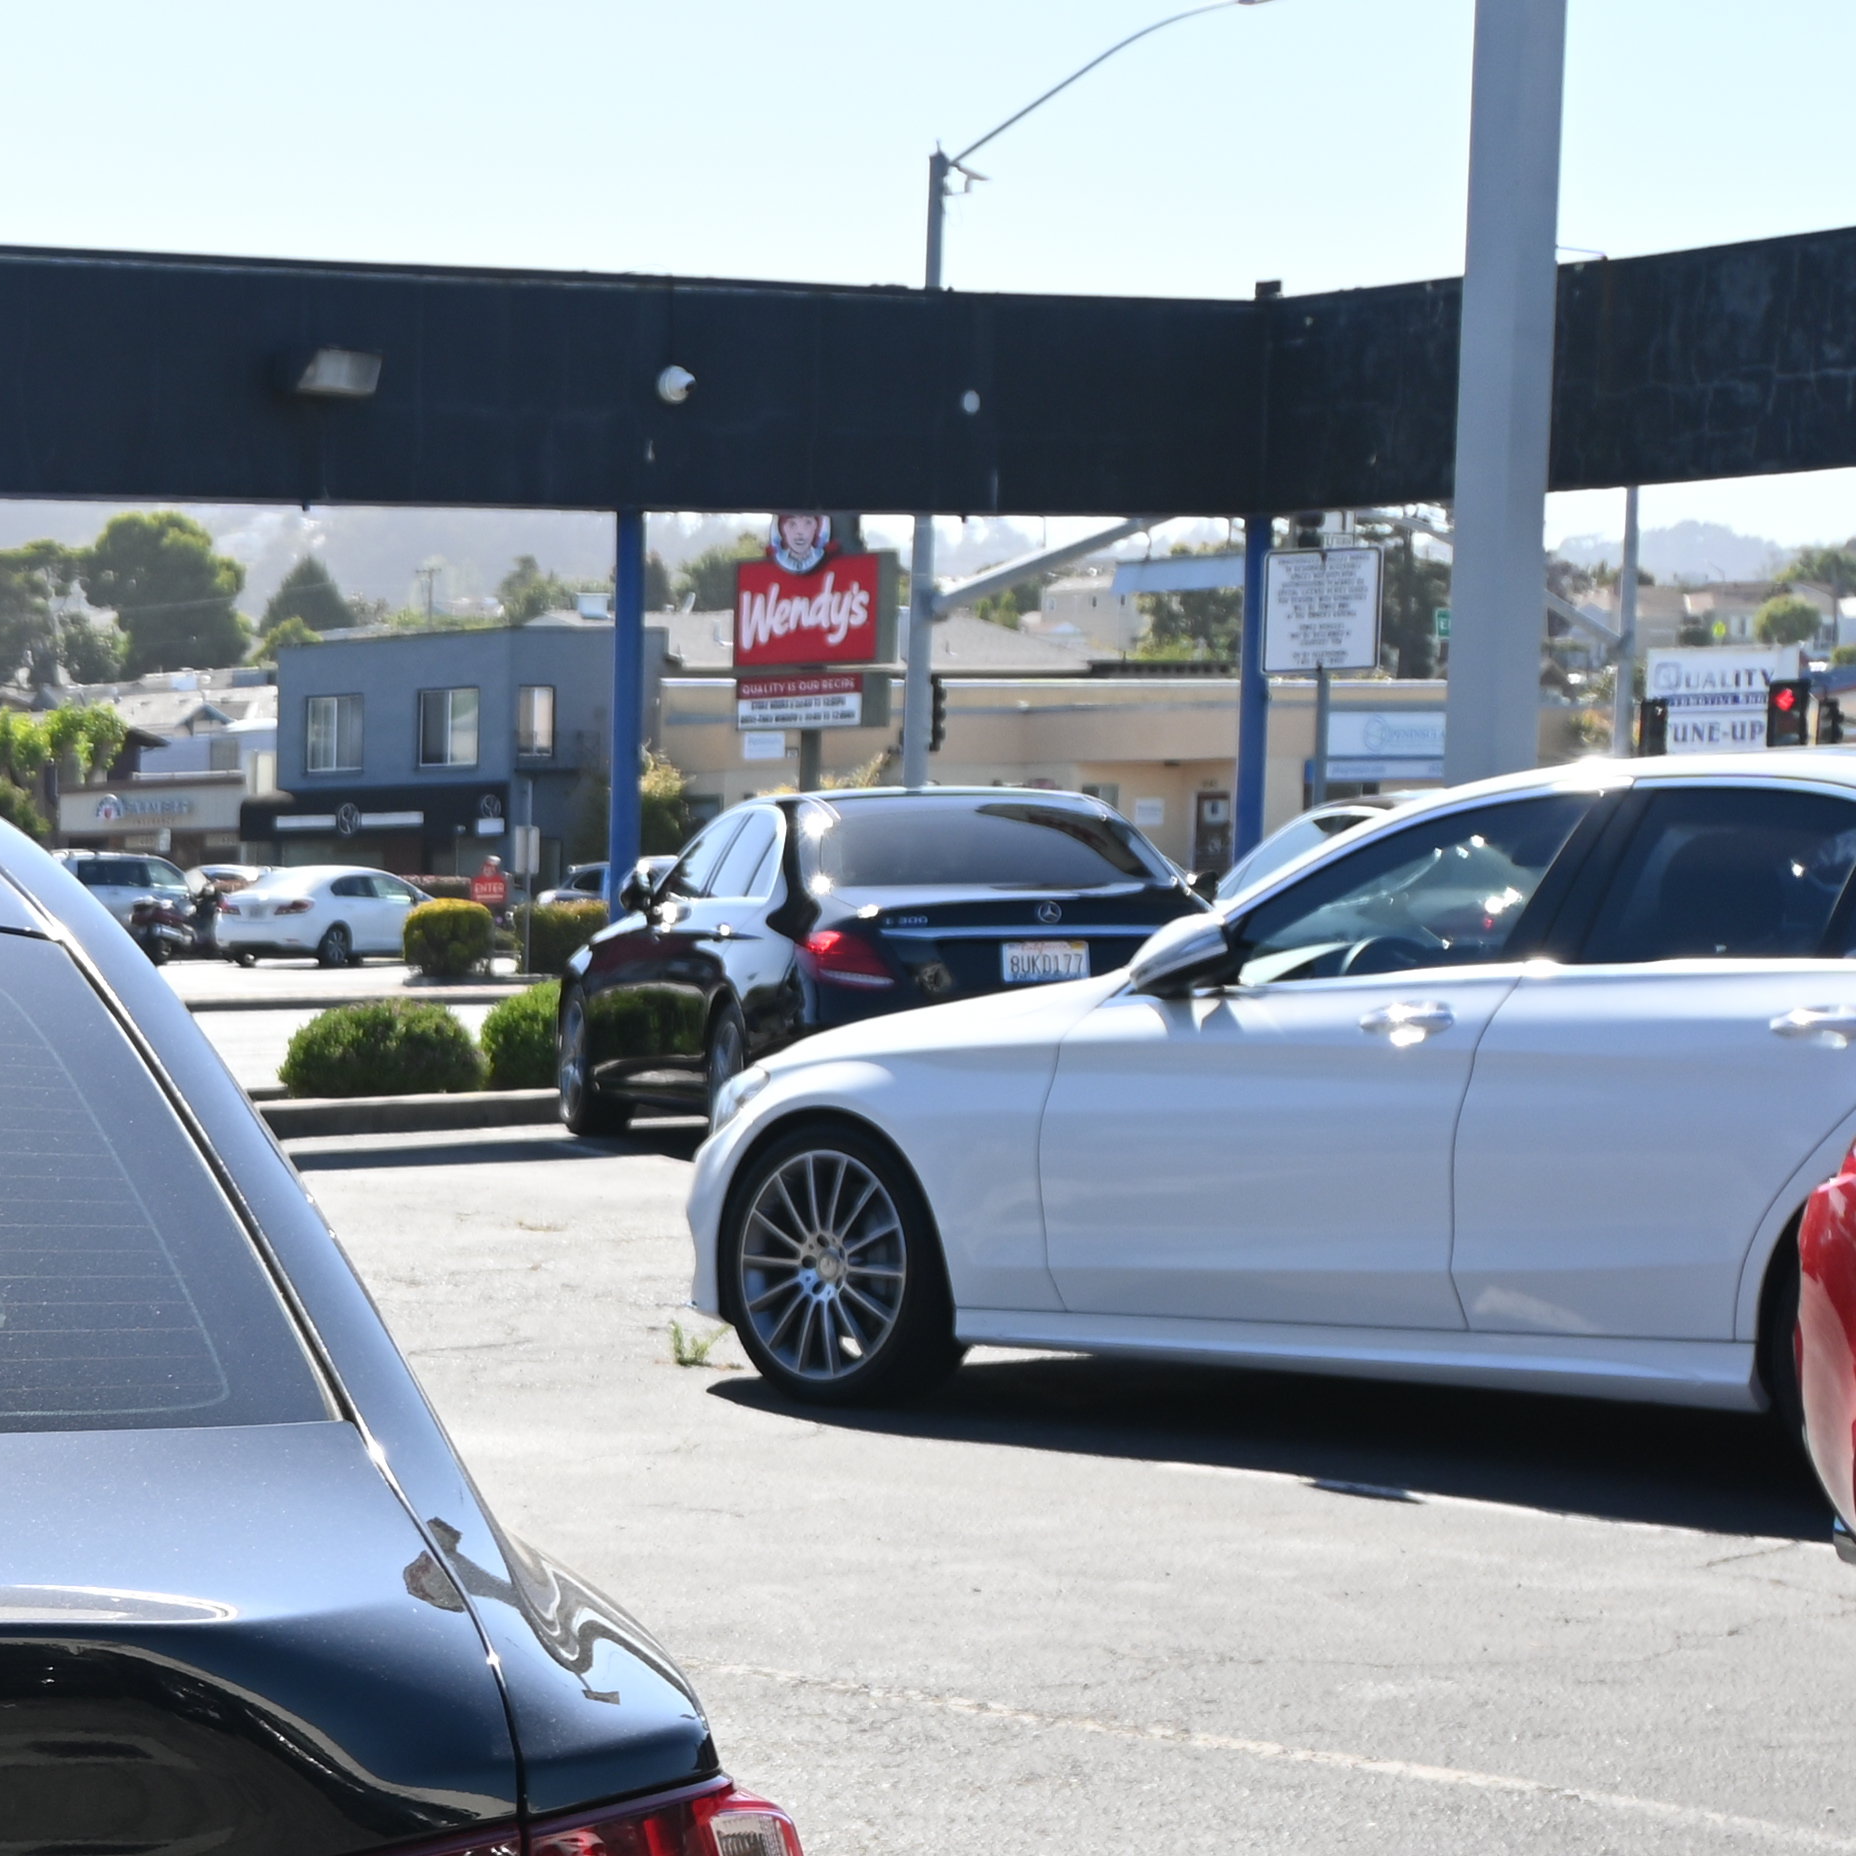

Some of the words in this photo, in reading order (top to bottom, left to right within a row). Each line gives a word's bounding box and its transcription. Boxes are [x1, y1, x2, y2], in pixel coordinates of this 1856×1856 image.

[741, 571, 871, 652] Wendy's
[742, 682, 786, 696] QUALITY
[788, 680, 797, 692] IS
[799, 678, 821, 691] OUR
[823, 676, 855, 690] RECIPE
[1668, 719, 1765, 743] UNE-UP
